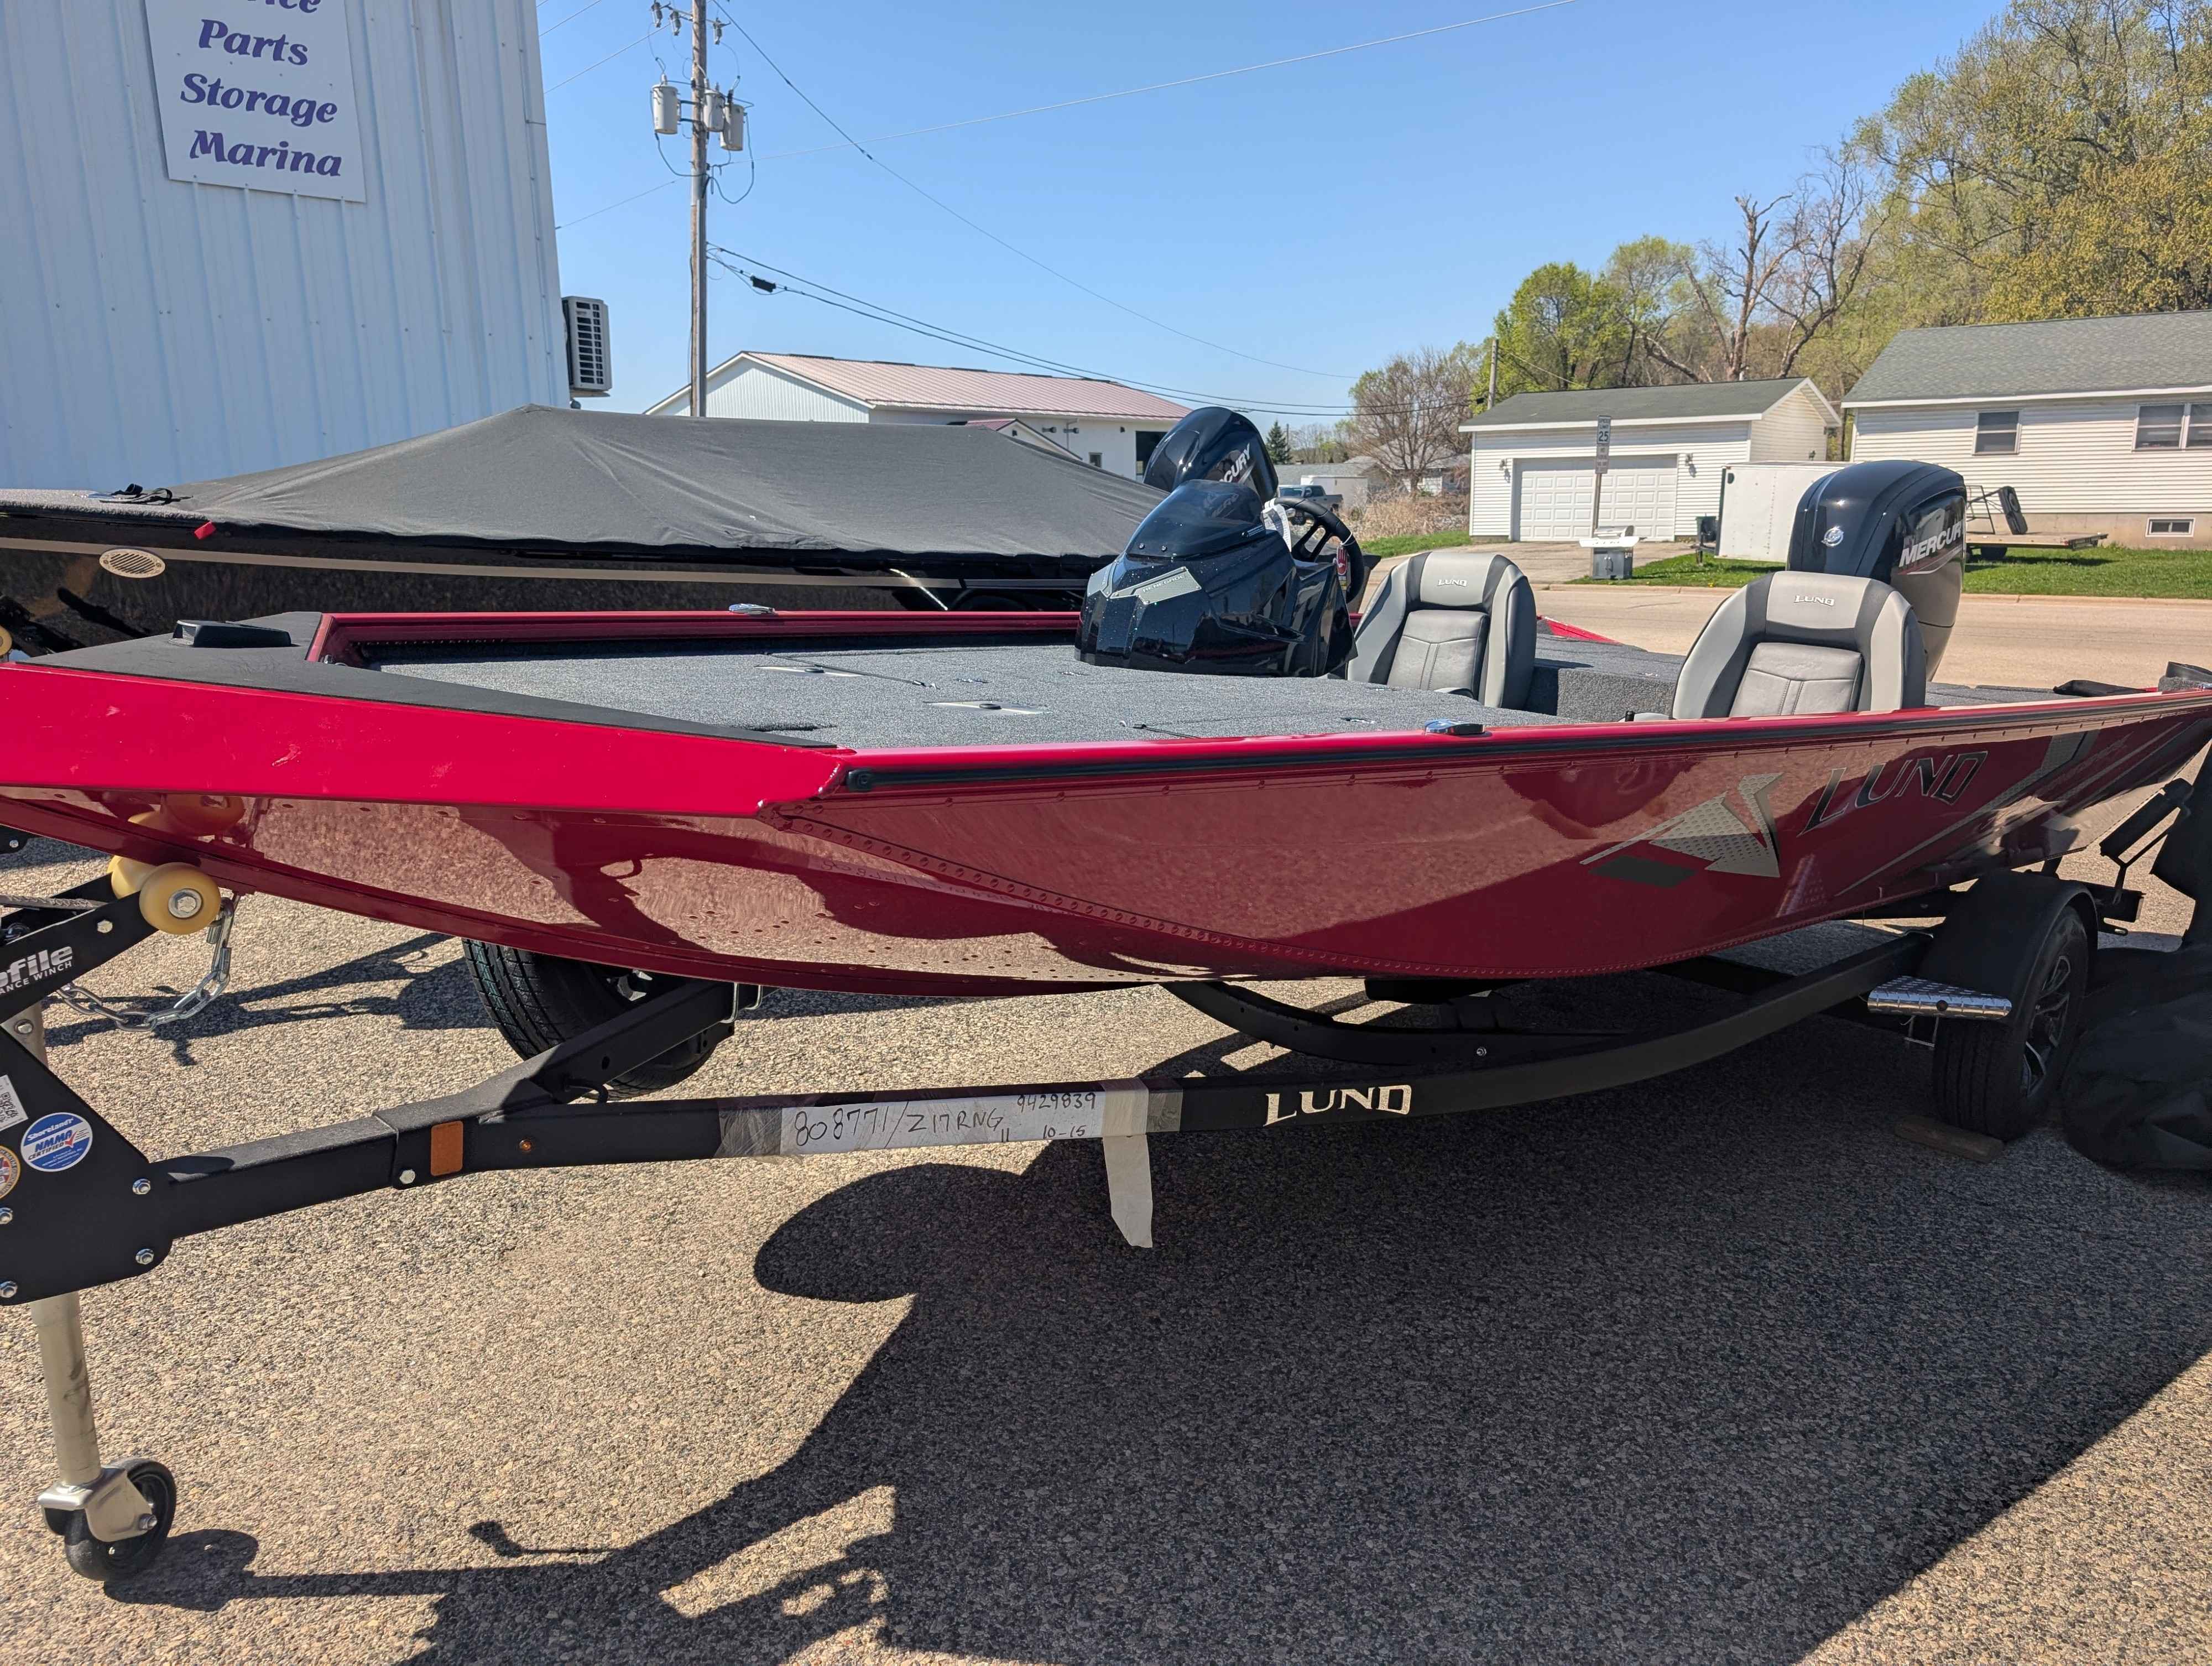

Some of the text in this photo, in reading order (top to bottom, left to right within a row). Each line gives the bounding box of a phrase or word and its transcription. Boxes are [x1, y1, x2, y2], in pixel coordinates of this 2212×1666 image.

[199, 19, 308, 65] Parts
[180, 73, 337, 127] Storage
[190, 130, 342, 176] Marina
[1599, 431, 1608, 441] 25
[1219, 442, 1250, 482] CURY
[1142, 574, 1187, 593] RENEGADE
[1438, 579, 1467, 587] LUND
[1794, 595, 1835, 607] LUND
[1796, 751, 1988, 838] LUND
[33, 960, 72, 981] WINCH
[1017, 1092, 1096, 1112] 9429839
[1263, 1084, 1412, 1127] LUND
[28, 1142, 64, 1161] CERTIFIED
